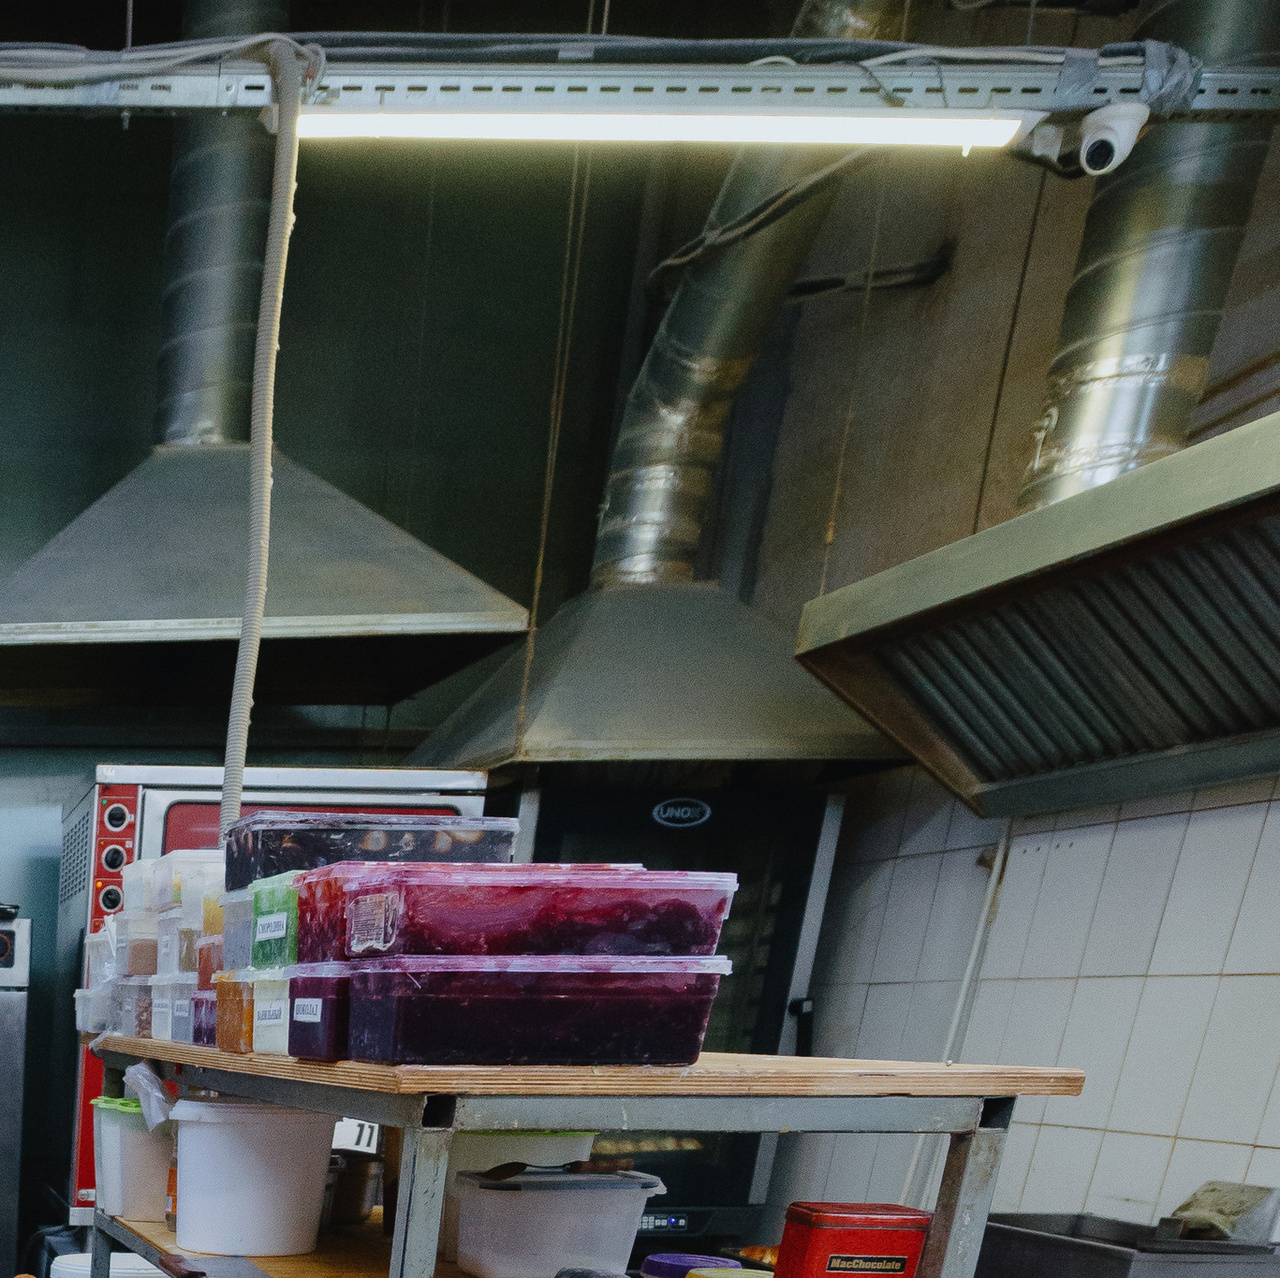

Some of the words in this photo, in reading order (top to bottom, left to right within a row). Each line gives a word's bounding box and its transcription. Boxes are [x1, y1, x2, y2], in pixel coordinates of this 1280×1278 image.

[660, 806, 701, 818] UNOX
[355, 1123, 375, 1147] 11
[830, 1258, 901, 1270] MacChocolate
